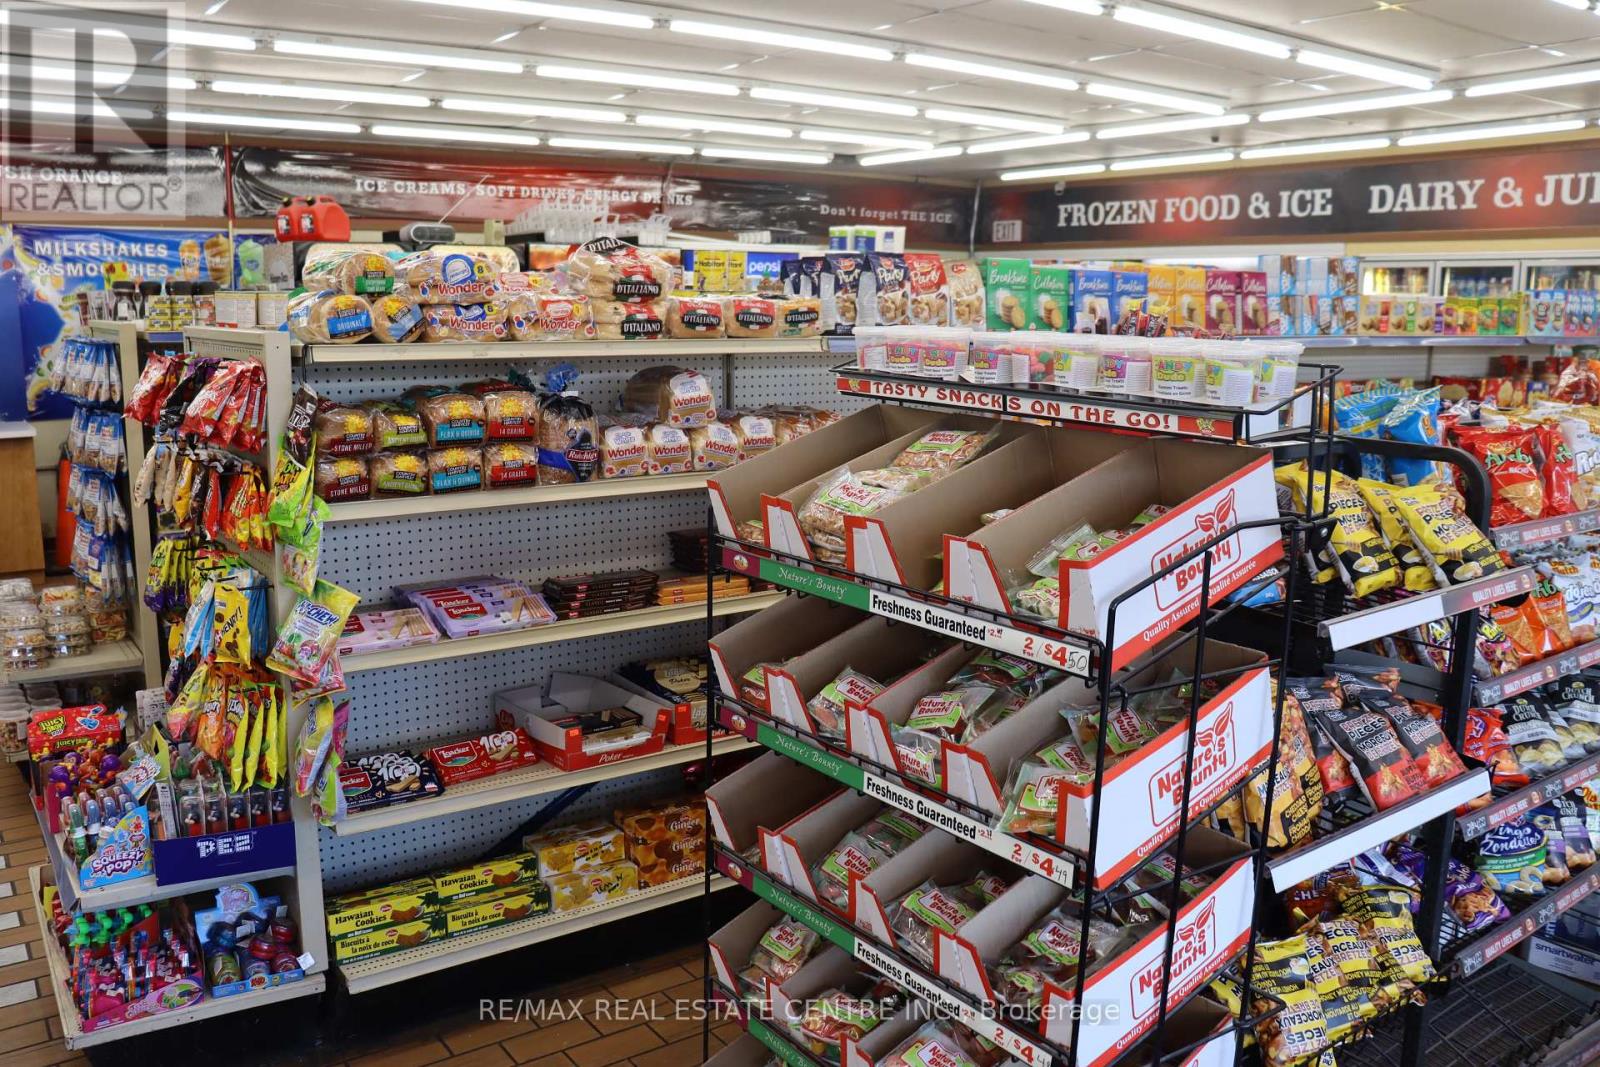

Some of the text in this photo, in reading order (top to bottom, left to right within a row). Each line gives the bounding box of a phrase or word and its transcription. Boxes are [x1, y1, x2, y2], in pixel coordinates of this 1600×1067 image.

[40, 167, 122, 186] ORANGE
[355, 179, 387, 193] ICE
[394, 180, 466, 196] CREAMS
[476, 184, 516, 198] SOFT
[642, 190, 694, 206] DRNKS
[1368, 179, 1485, 213] DAIRY
[1493, 177, 1524, 208] &
[819, 204, 953, 224] Don't forget THE ICE
[1058, 188, 1334, 228] FROZEN FOOD & ICE
[995, 223, 1016, 242] EXIT
[34, 239, 168, 258] MILKSHAKES
[748, 260, 782, 277] pepsi
[911, 269, 941, 286] Party
[438, 282, 485, 297] Wonder
[449, 316, 495, 331] Wonder
[539, 317, 582, 331] Wonder
[623, 321, 661, 337] D'ITALIANO
[672, 394, 711, 409] Wonder
[873, 381, 1172, 429] TASTY SNACKS ON THE GO!
[705, 441, 738, 457] Wonder
[743, 436, 775, 448] Wonder
[608, 446, 646, 460] Wonder
[653, 447, 690, 460] Wonder
[778, 566, 986, 642] Nature's Bounty Freshness Guaranteed
[1143, 616, 1171, 642] Quality
[1170, 599, 1200, 629] Assured
[1229, 561, 1256, 584] Assurée
[1472, 589, 1492, 602] QUALITY
[450, 605, 482, 618] Loacker
[1024, 637, 1034, 650] 2
[1043, 643, 1068, 667] $4
[1067, 650, 1087, 673] 50
[40, 717, 65, 731] JUICY
[439, 746, 470, 763] Loacker
[599, 753, 622, 765] Poker
[1156, 737, 1227, 799] Naure's
[775, 734, 977, 841] Nature's Bounty Freshness Guaranteed
[1171, 752, 1227, 807] Bunty
[670, 816, 702, 833] Ginger
[1136, 832, 1164, 858] Quality
[1198, 782, 1225, 809] Qualité
[196, 833, 253, 858] PEZ
[671, 838, 703, 853] Ginger
[1013, 843, 1023, 856] 2
[92, 850, 145, 873] SQUEEZY
[105, 860, 133, 876] POP
[671, 860, 703, 874] Ginger
[1031, 852, 1055, 878] $4
[459, 877, 489, 890] Cookies
[355, 914, 387, 928] Cookies
[451, 912, 473, 922] Biscuits
[481, 915, 489, 923] de
[489, 911, 502, 921] coco
[340, 938, 362, 950] Biscuits
[358, 943, 372, 953] noix
[373, 941, 381, 950] de
[769, 888, 803, 913] Nature's
[803, 908, 836, 937] Bounty
[857, 942, 903, 980] Freshness
[904, 973, 961, 1018] Guaranteed
[1535, 942, 1599, 968] smartwater
[1138, 930, 1207, 994] Naure's
[1151, 940, 1208, 997] Bunty
[995, 1027, 1004, 1041] 2
[1116, 1027, 1142, 1051] Quality
[1013, 1037, 1035, 1064] $4
